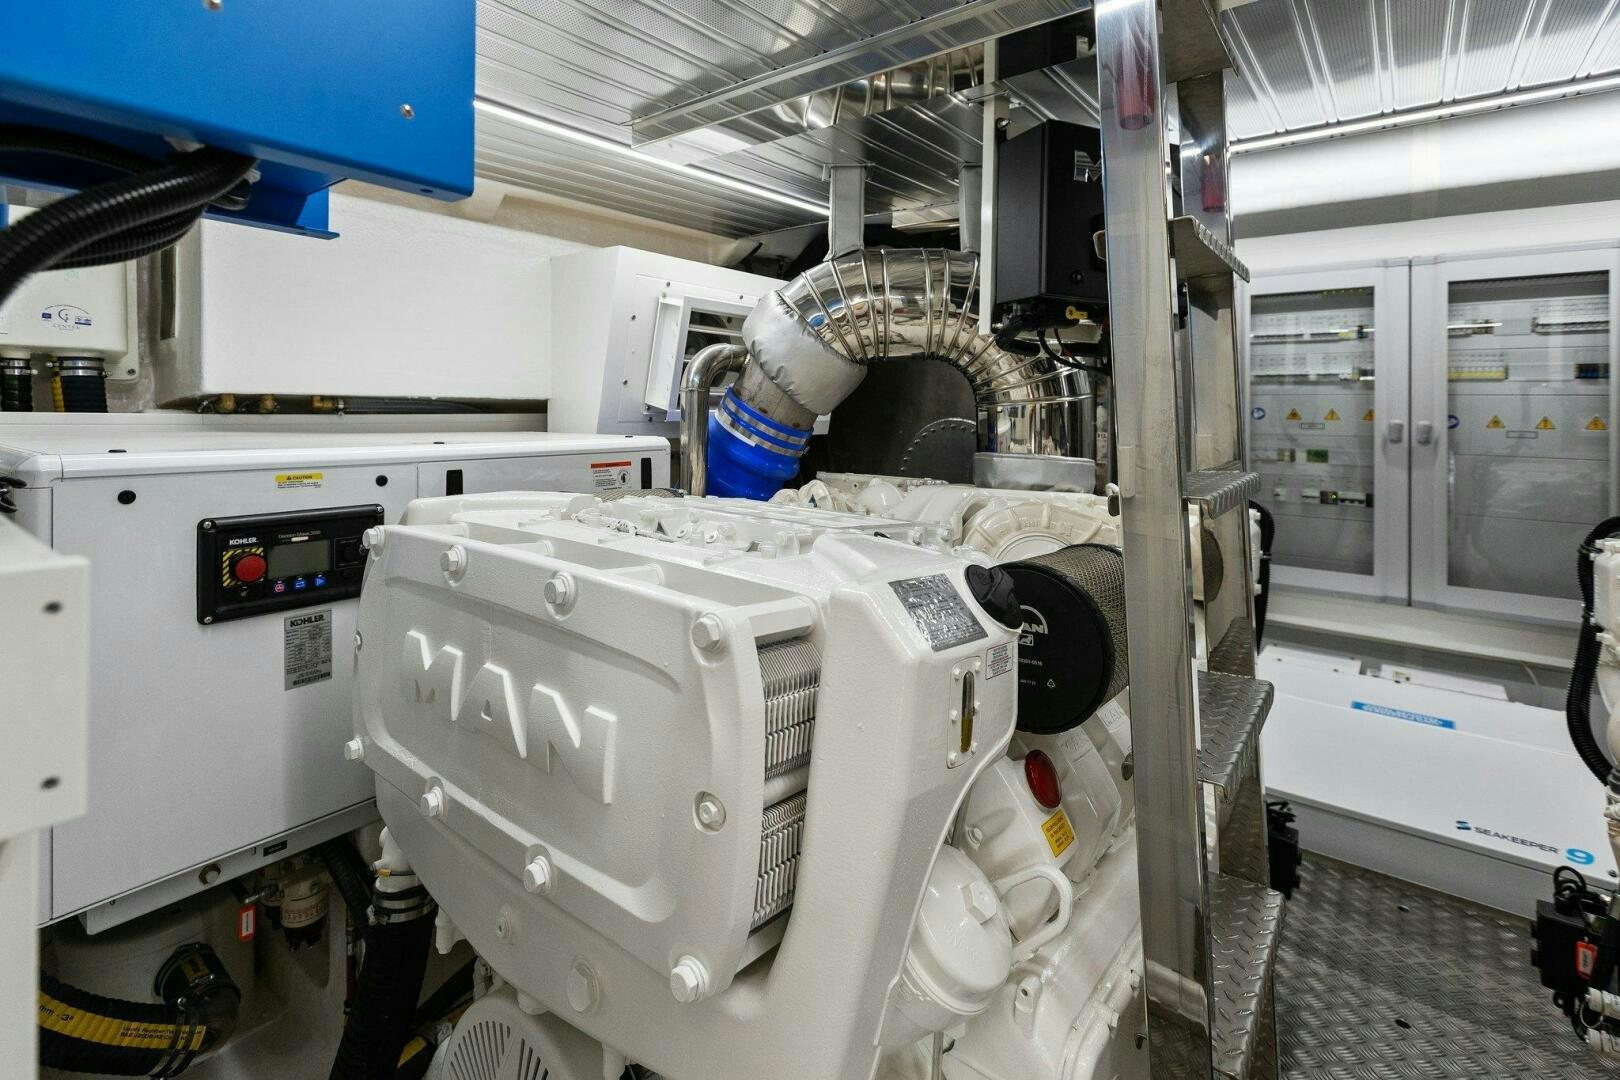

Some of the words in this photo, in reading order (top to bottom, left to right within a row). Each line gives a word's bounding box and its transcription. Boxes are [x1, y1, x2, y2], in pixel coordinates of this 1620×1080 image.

[229, 537, 257, 546] KOHLER
[290, 614, 325, 628] KOHLER
[402, 629, 618, 806] MAN
[1473, 826, 1559, 855] SEAKEEPER
[1565, 848, 1595, 865] 9
